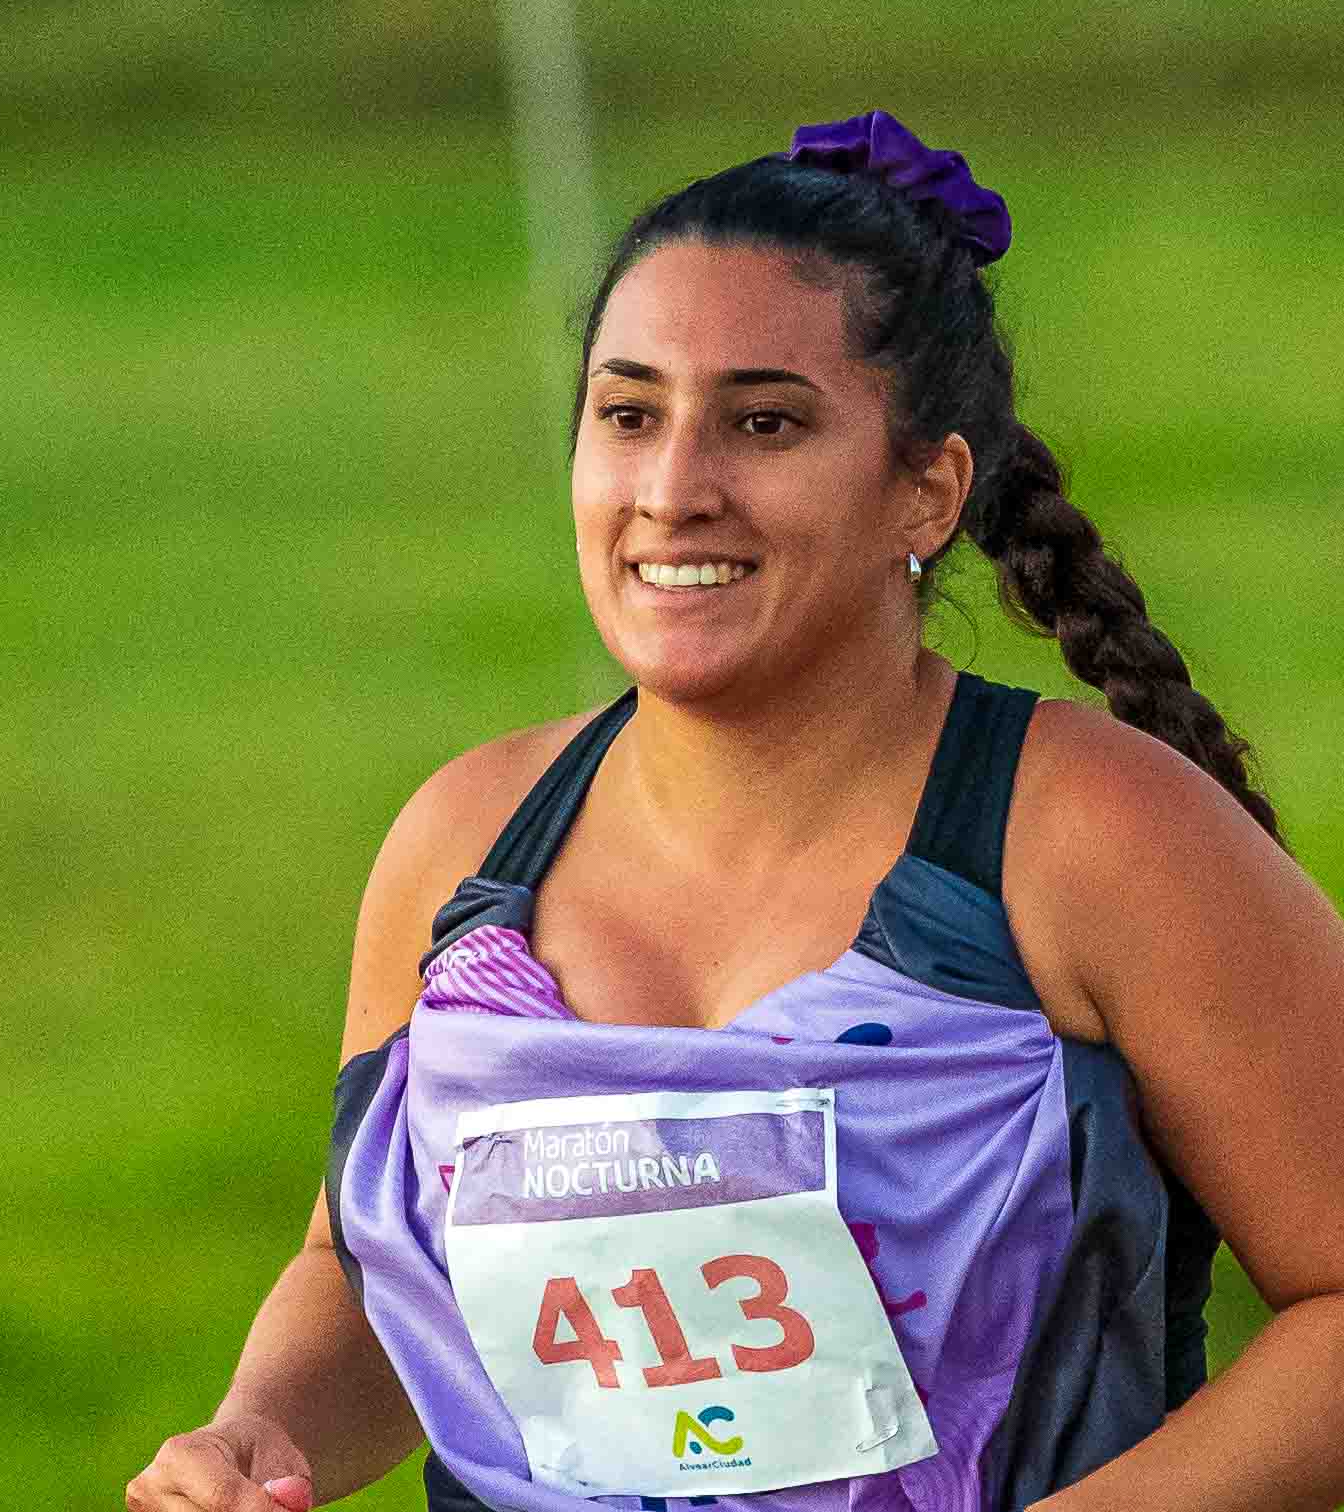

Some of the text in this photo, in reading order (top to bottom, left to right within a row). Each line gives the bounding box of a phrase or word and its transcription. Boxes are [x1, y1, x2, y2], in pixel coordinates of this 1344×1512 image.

[524, 1123, 629, 1160] Maratón
[523, 1152, 721, 1199] NOCTURNA
[533, 1255, 814, 1388] 413
